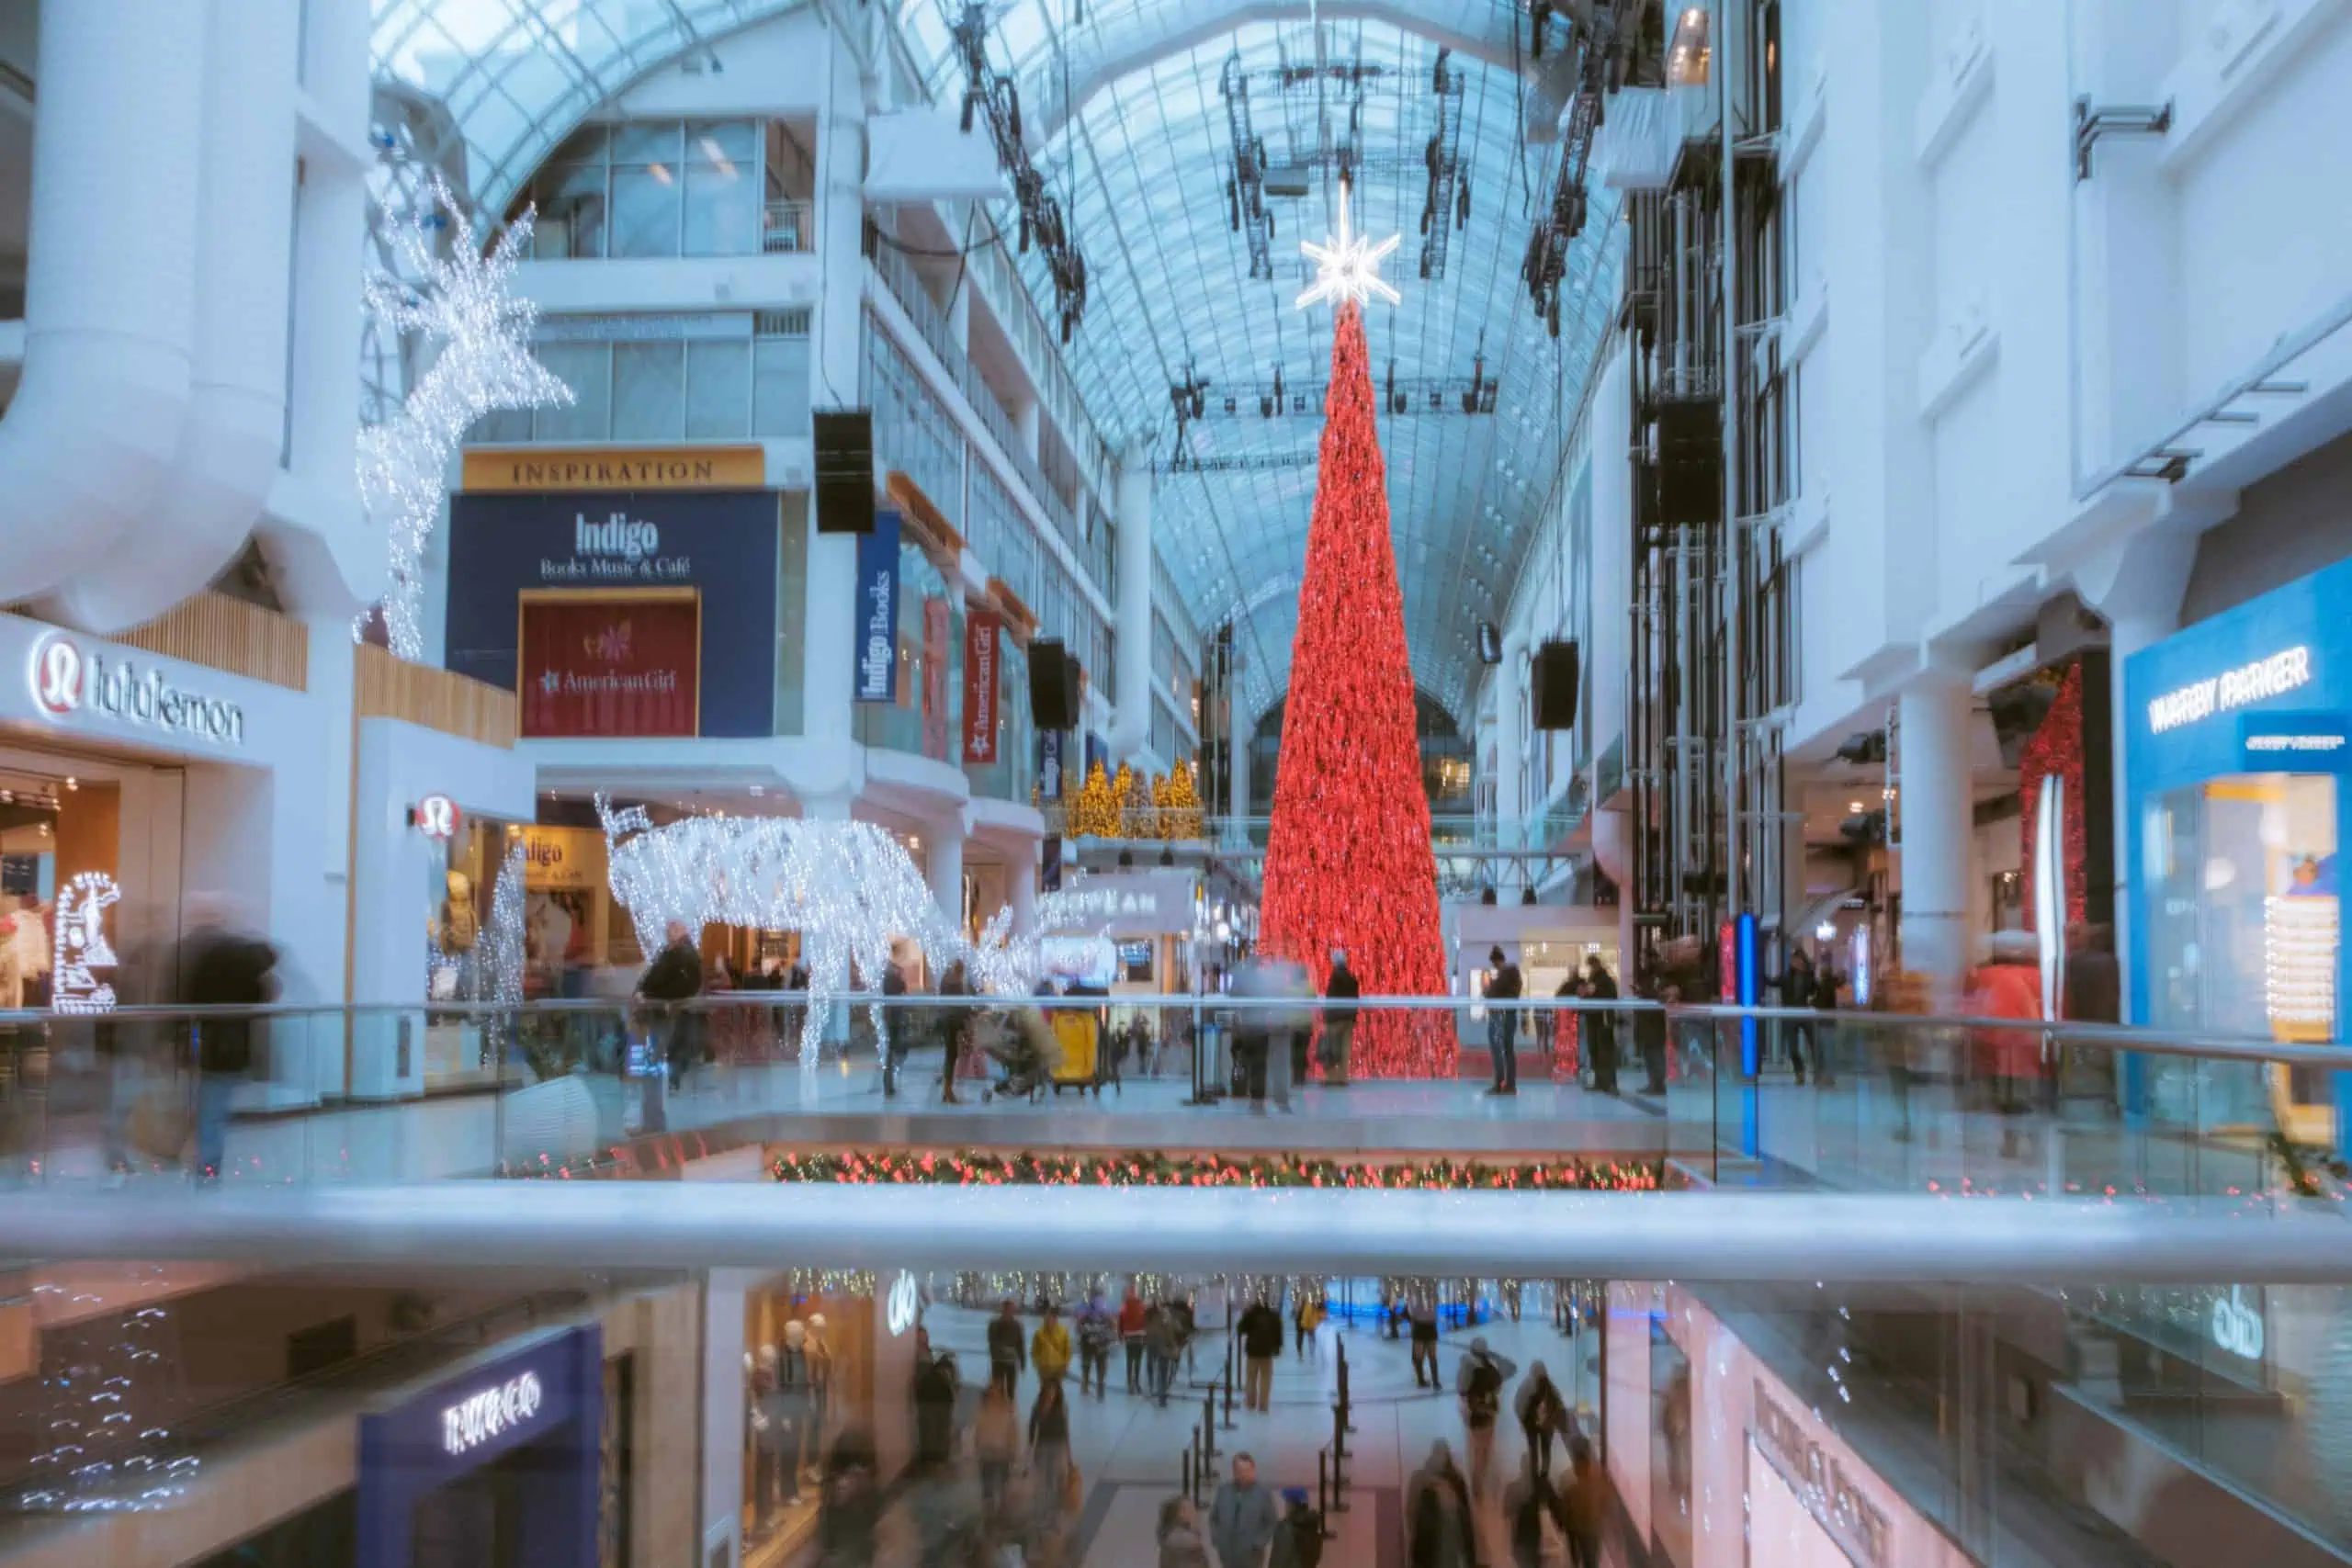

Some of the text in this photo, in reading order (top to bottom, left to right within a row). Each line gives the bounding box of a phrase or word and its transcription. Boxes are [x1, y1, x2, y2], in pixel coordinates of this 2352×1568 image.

[512, 460, 714, 483] INSPIRATION
[575, 512, 660, 561] Indigo
[540, 557, 587, 576] Books
[591, 557, 636, 576] Music
[861, 570, 893, 699] Indigo Books
[88, 653, 244, 745] lululemon
